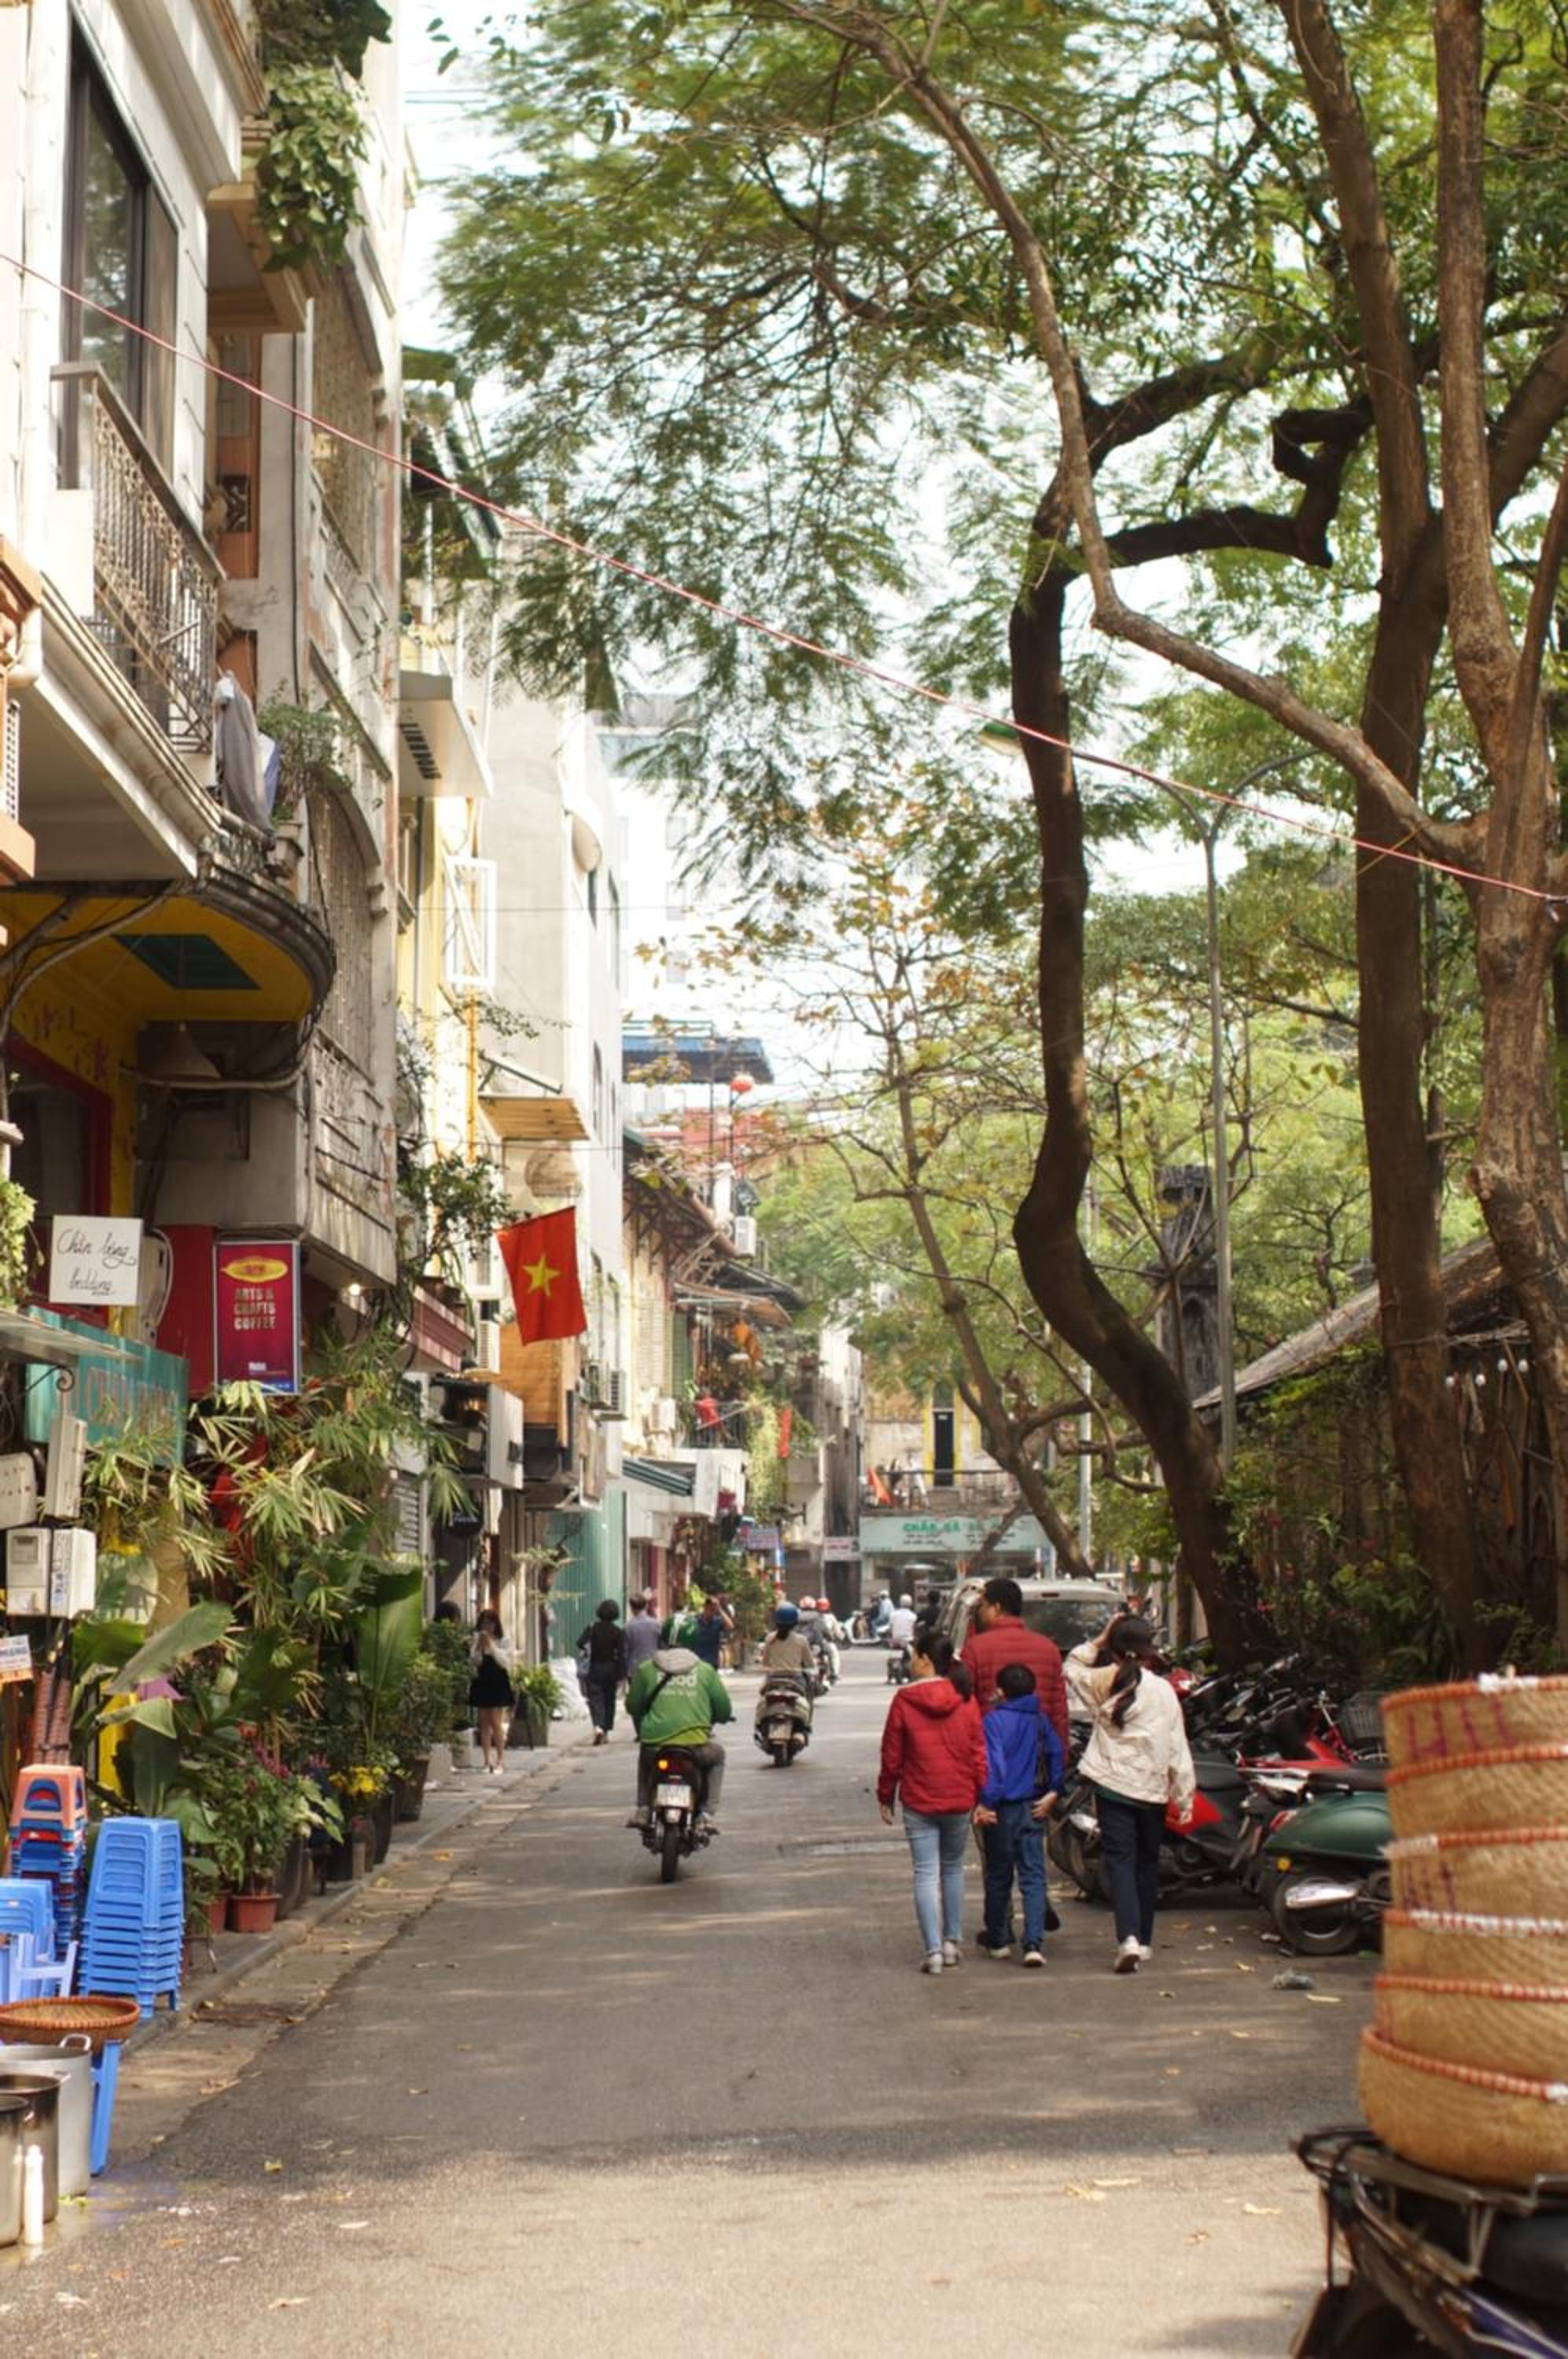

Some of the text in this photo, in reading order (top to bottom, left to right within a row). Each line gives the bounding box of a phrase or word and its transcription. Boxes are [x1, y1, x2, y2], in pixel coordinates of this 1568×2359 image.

[234, 1287, 263, 1300] ARTS
[234, 1301, 276, 1315] CRAFTS
[234, 1316, 276, 1330] COFFEE
